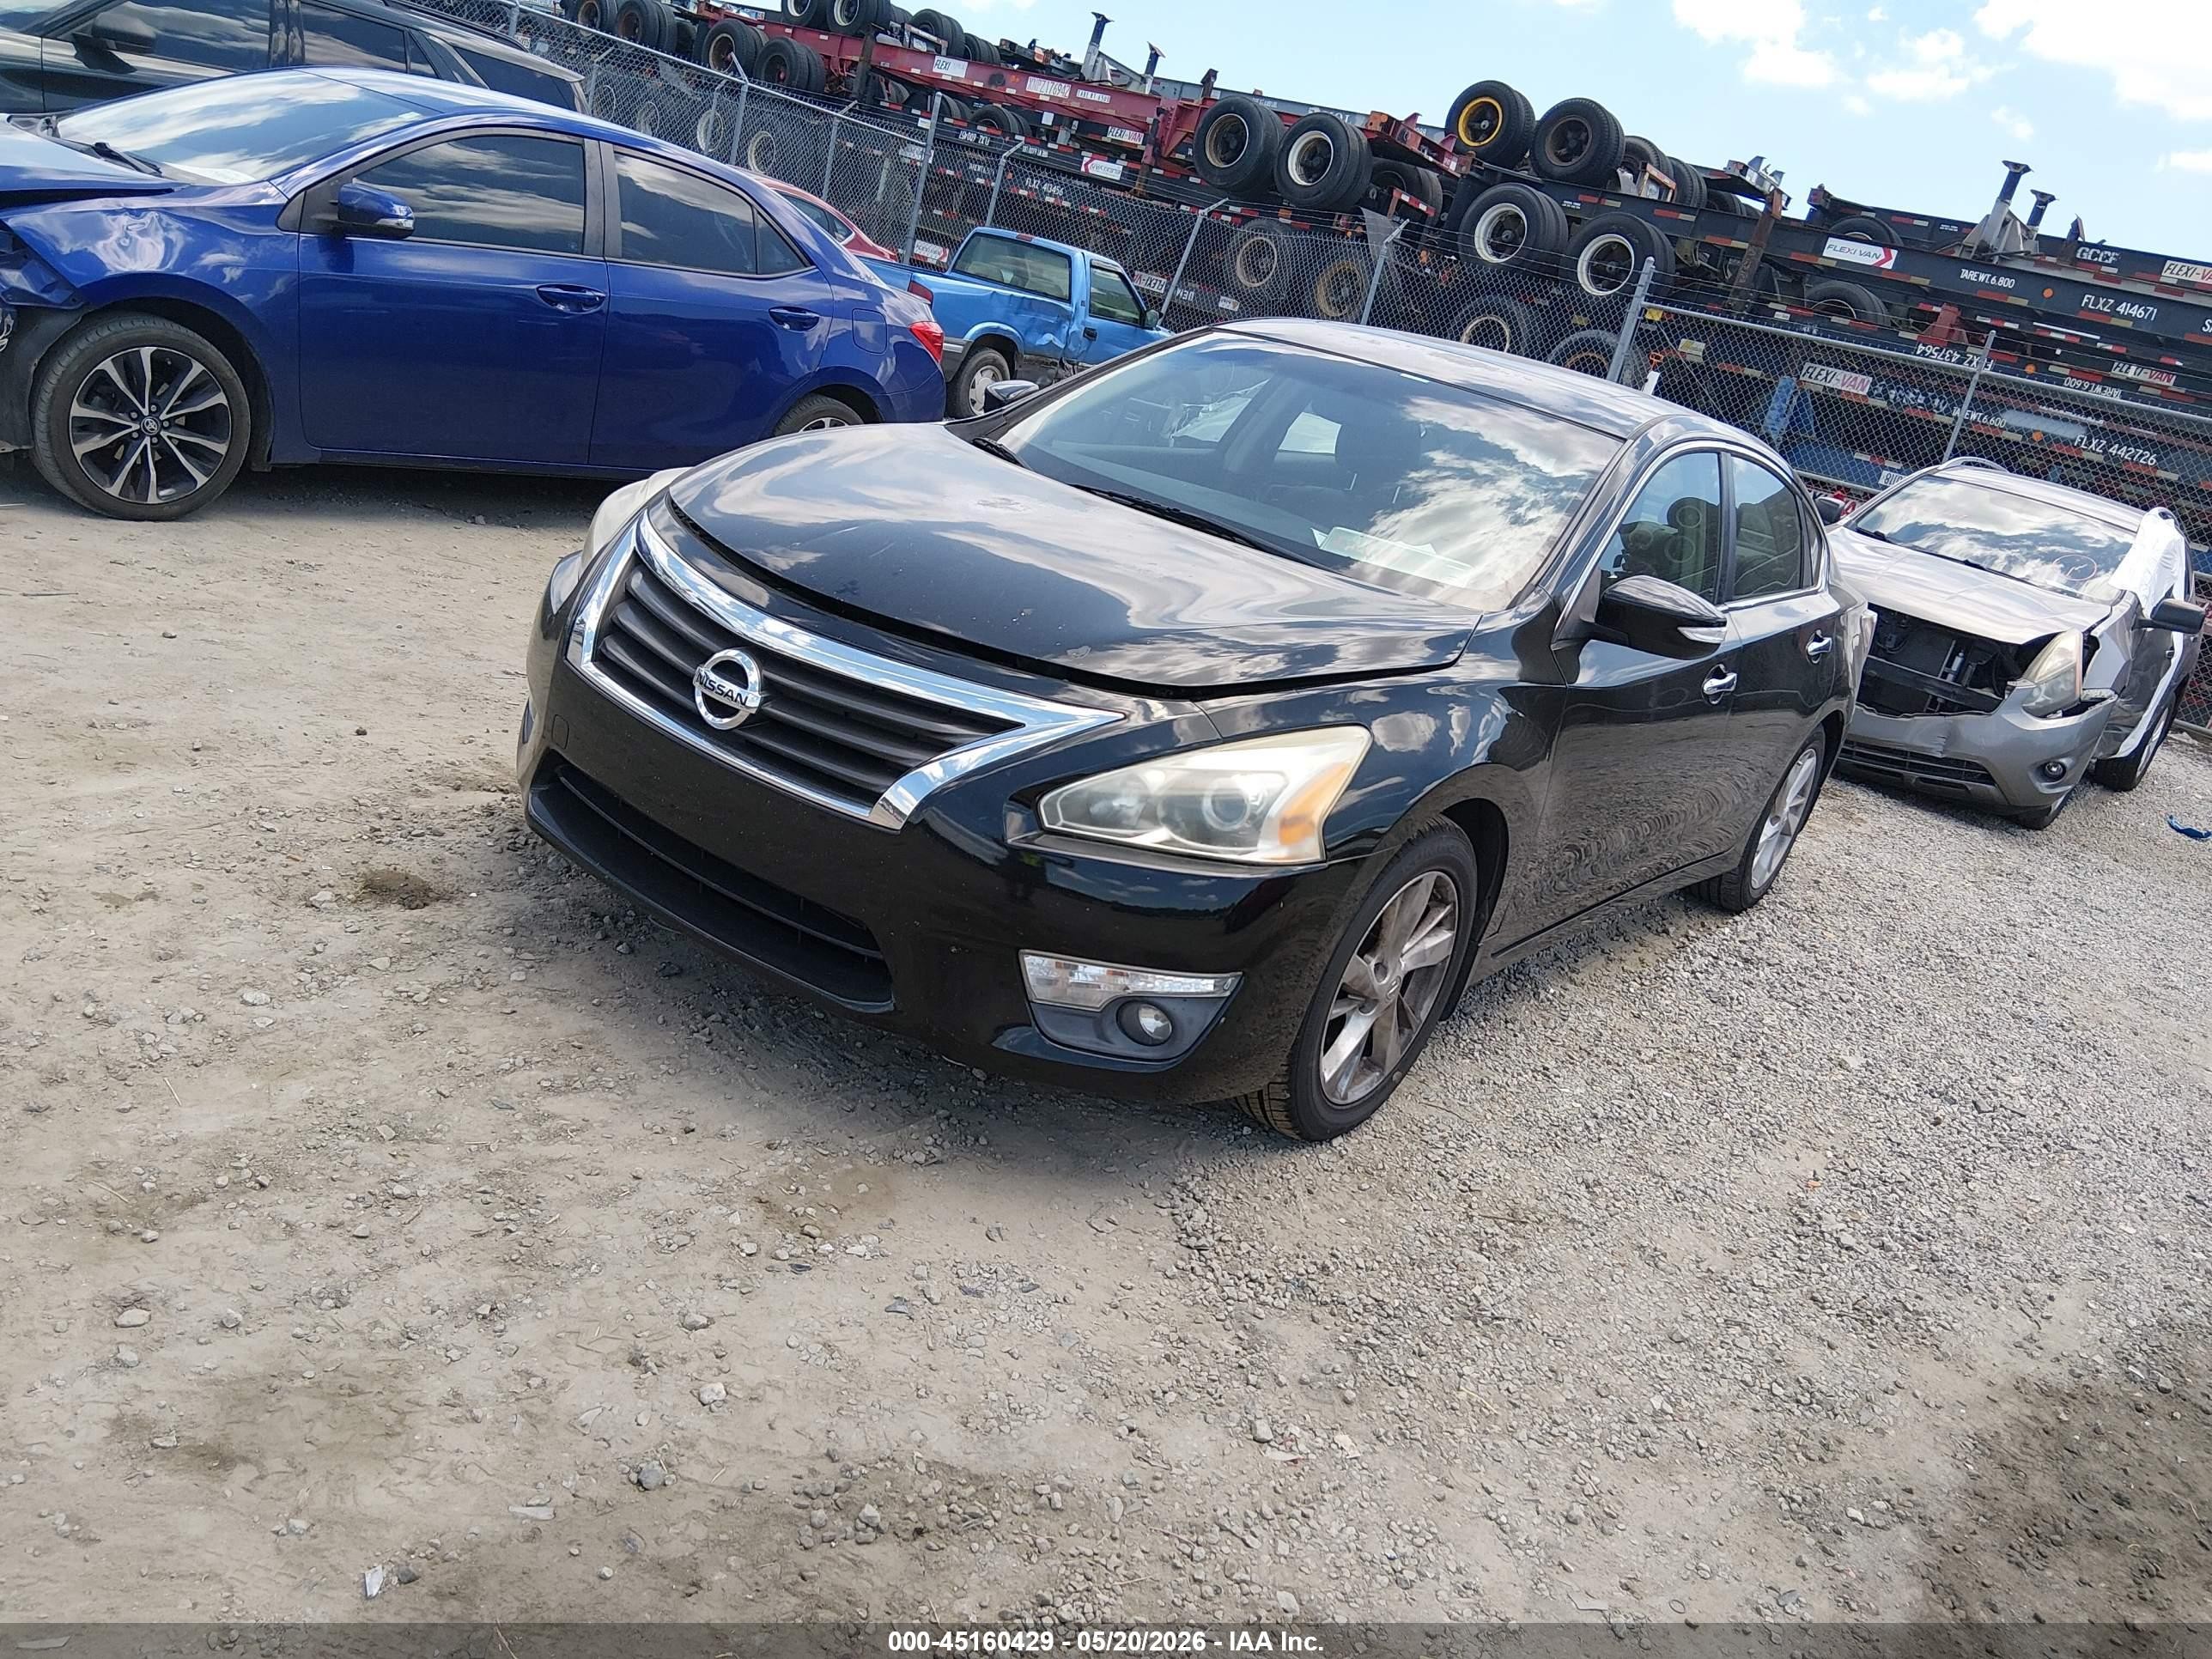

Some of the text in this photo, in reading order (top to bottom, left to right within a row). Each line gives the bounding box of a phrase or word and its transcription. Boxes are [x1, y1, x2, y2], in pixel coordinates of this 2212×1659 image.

[1826, 244, 1882, 259] FLEXI VAN
[2081, 295, 2158, 321] FLXZ 414671
[1916, 343, 1995, 371] FXZ 437564
[1803, 365, 1870, 392] FLEXI-VAN
[2075, 434, 2157, 465] FLXZ 442726
[696, 672, 749, 706] NISSAN
